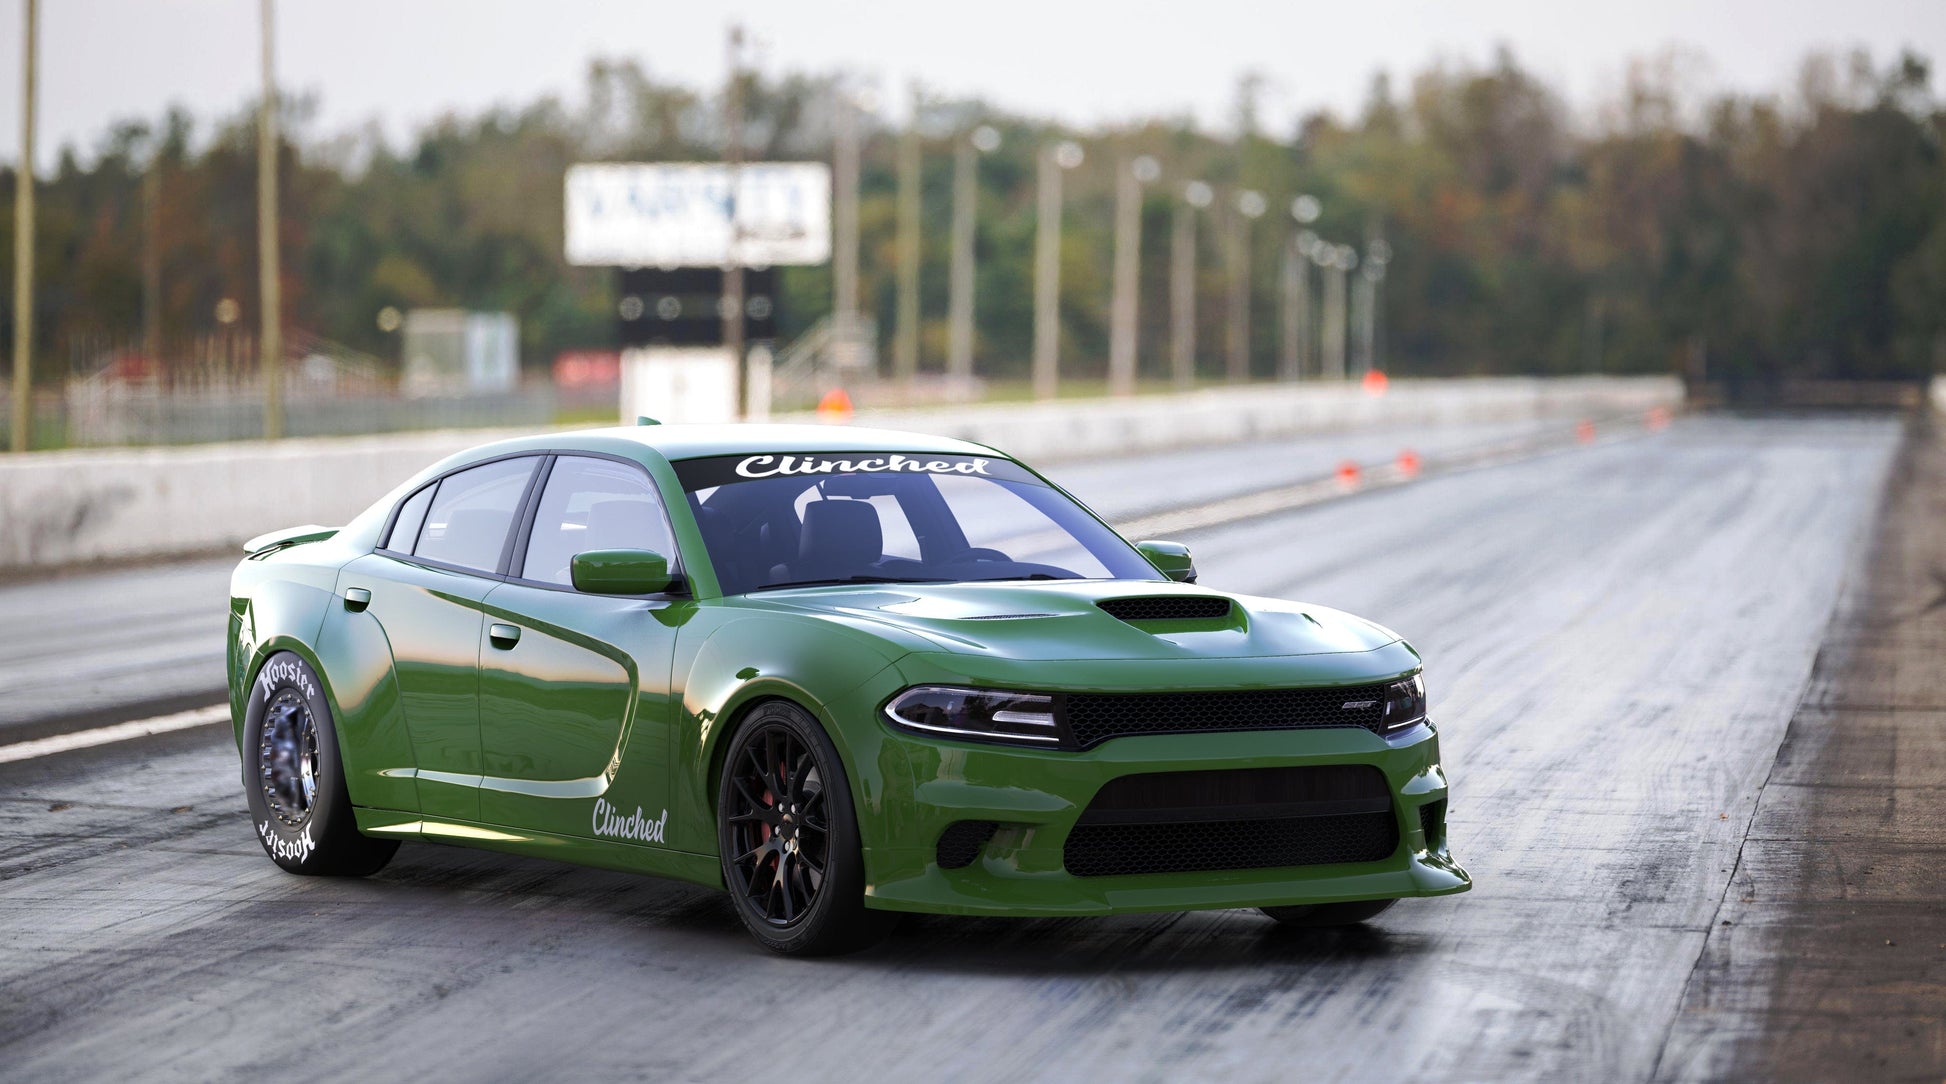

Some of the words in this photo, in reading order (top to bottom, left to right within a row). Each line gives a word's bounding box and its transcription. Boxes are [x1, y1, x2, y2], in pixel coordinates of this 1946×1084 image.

[735, 454, 992, 478] Clinched
[260, 659, 315, 703] Hoosier
[259, 819, 316, 865] Hoosier
[592, 797, 668, 844] Clinched
